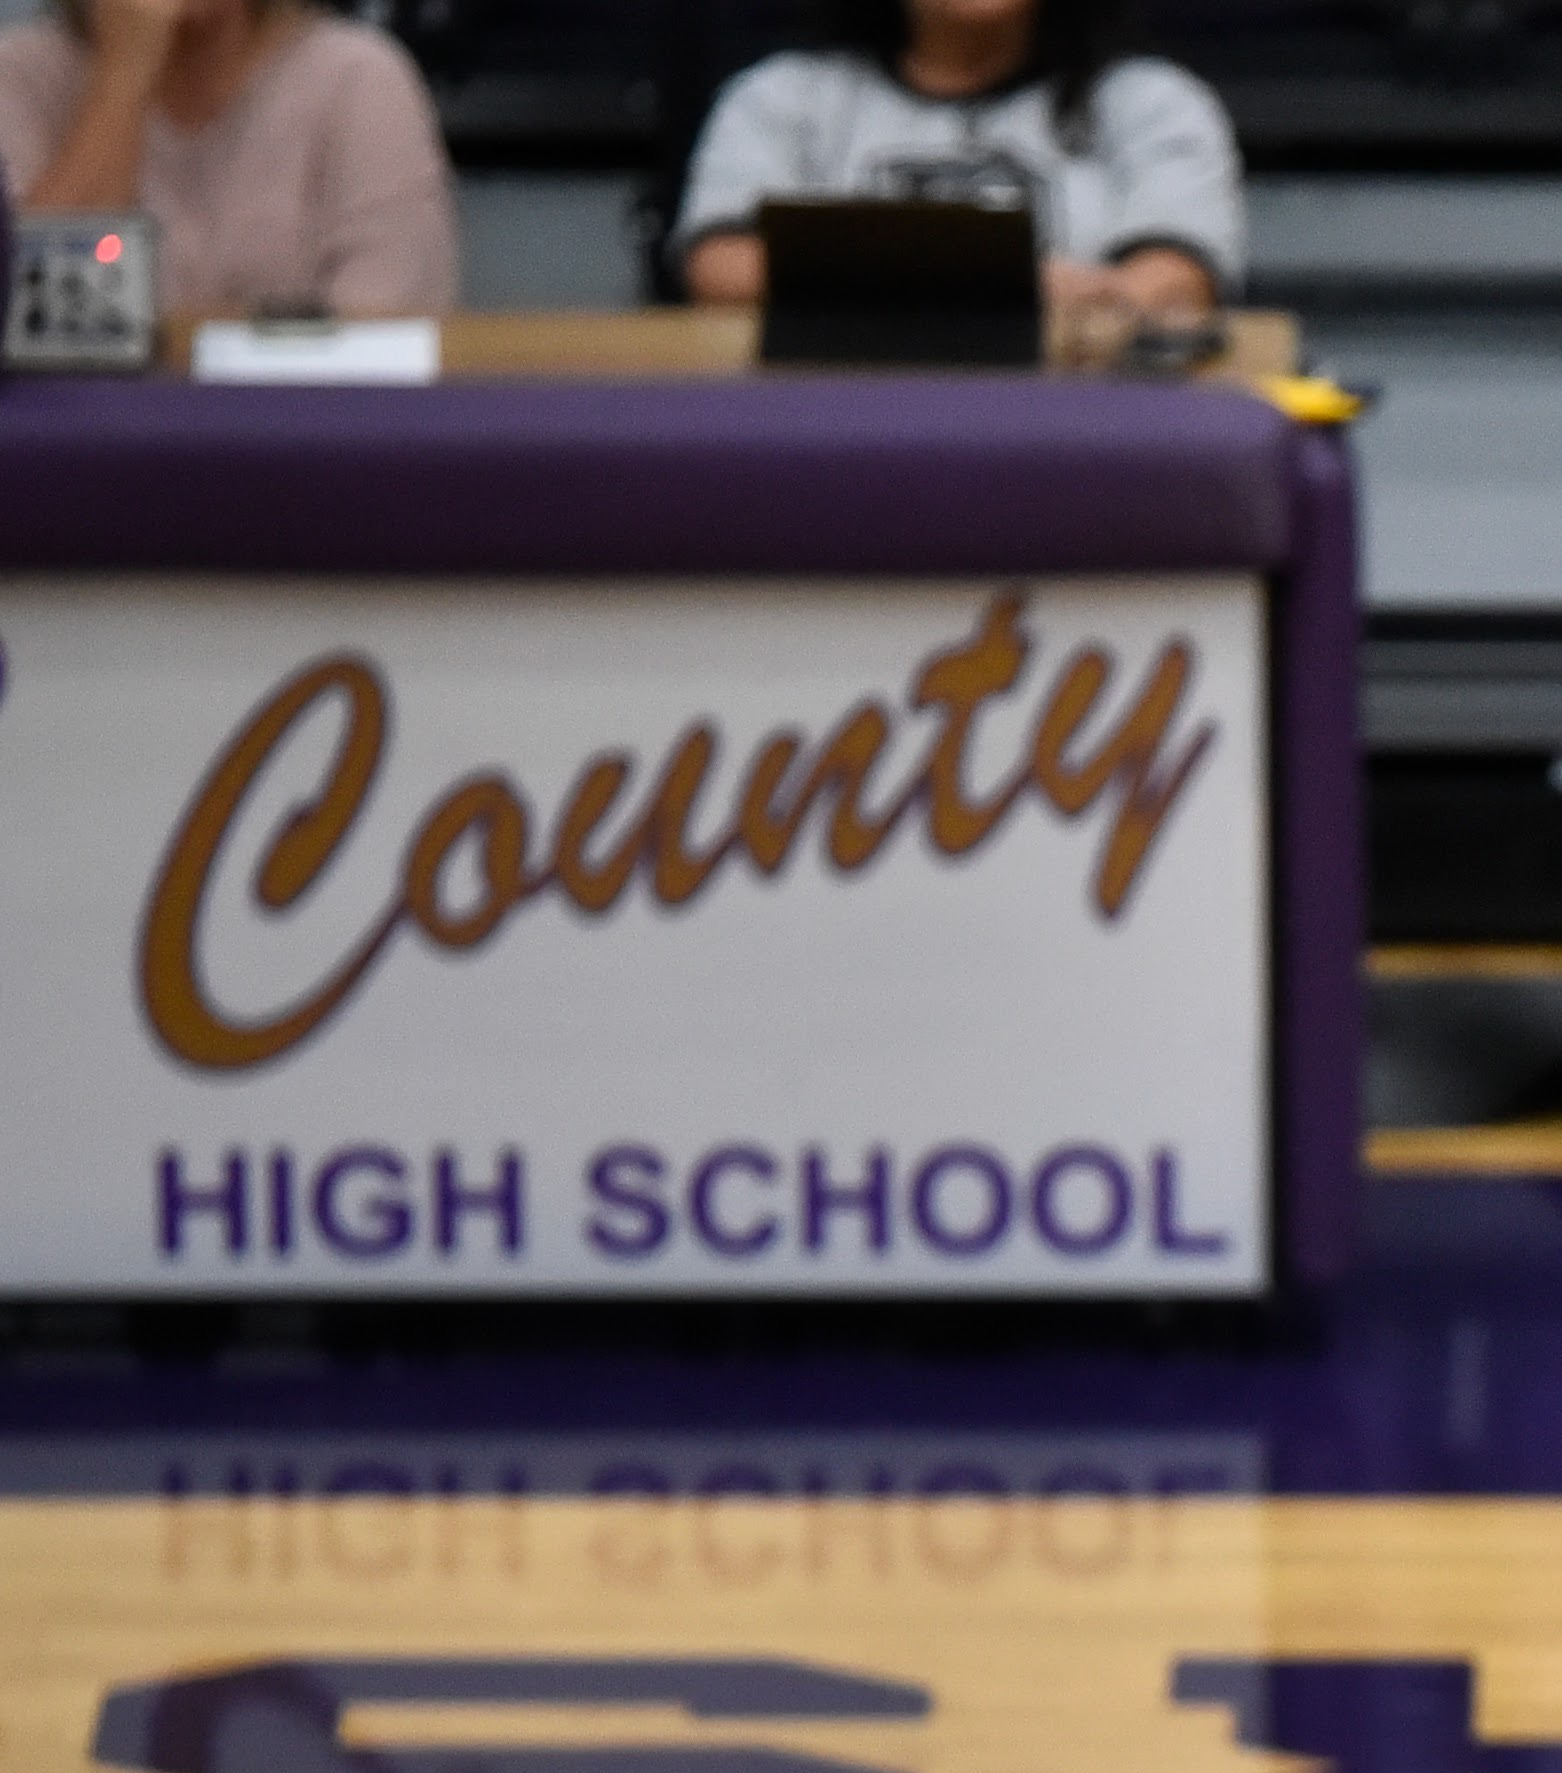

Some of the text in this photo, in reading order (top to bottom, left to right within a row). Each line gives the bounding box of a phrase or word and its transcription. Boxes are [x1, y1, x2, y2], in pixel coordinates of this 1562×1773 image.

[133, 582, 1216, 1081] County
[154, 1143, 1231, 1260] HIGH SCHOOL
